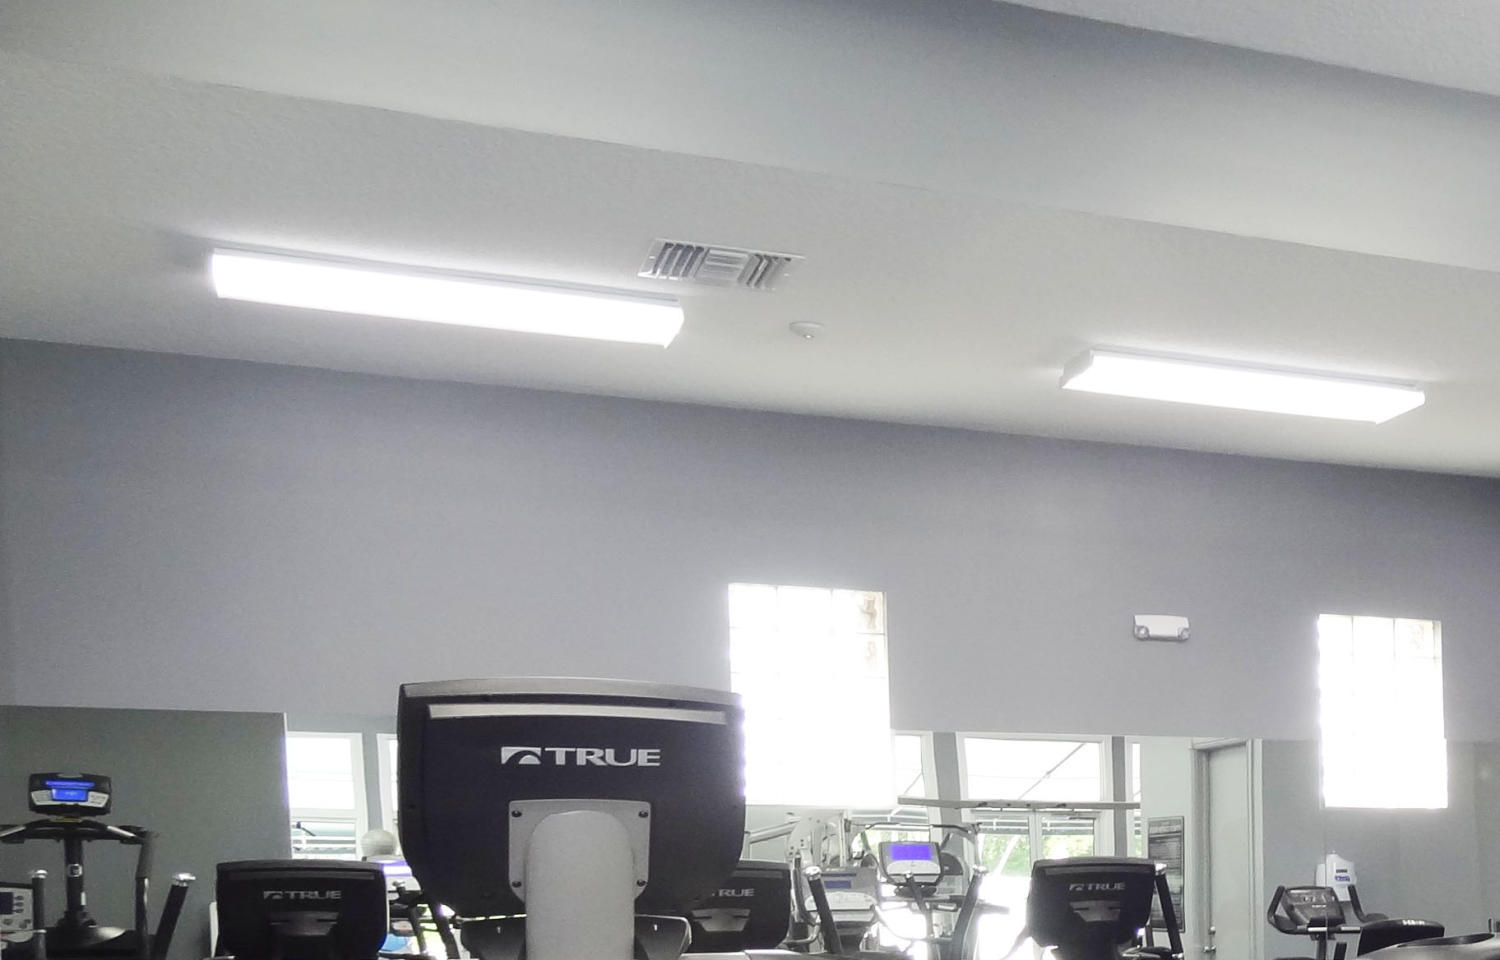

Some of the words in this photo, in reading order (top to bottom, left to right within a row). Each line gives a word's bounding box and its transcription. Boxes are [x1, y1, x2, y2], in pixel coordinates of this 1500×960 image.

[544, 747, 661, 766] TRUE
[1087, 882, 1126, 891] TRUE
[284, 890, 342, 900] TRUE
[712, 888, 755, 897] RUE
